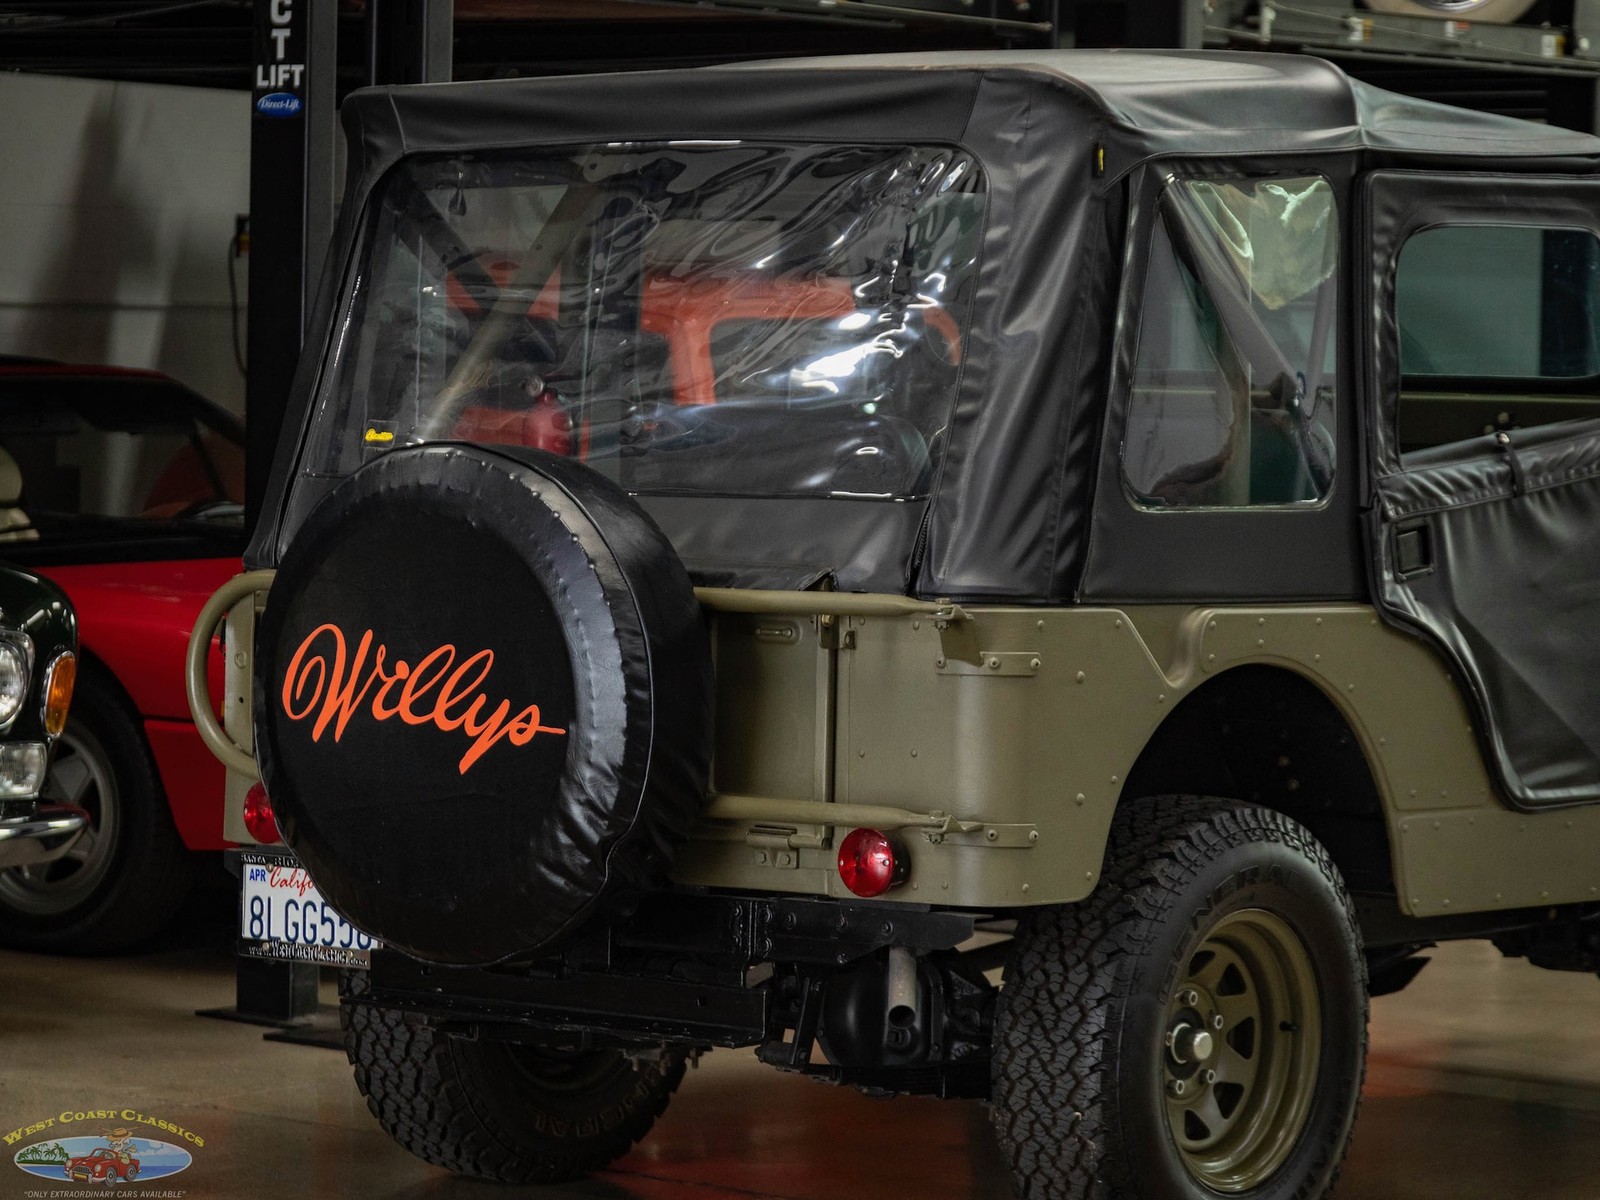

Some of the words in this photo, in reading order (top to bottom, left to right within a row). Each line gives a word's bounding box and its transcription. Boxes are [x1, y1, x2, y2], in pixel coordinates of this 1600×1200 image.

[256, 64, 305, 88] LIFT
[260, 99, 300, 111] Direct-Lift
[282, 623, 566, 775] Willys
[249, 868, 266, 882] APR
[270, 865, 315, 896] Califo
